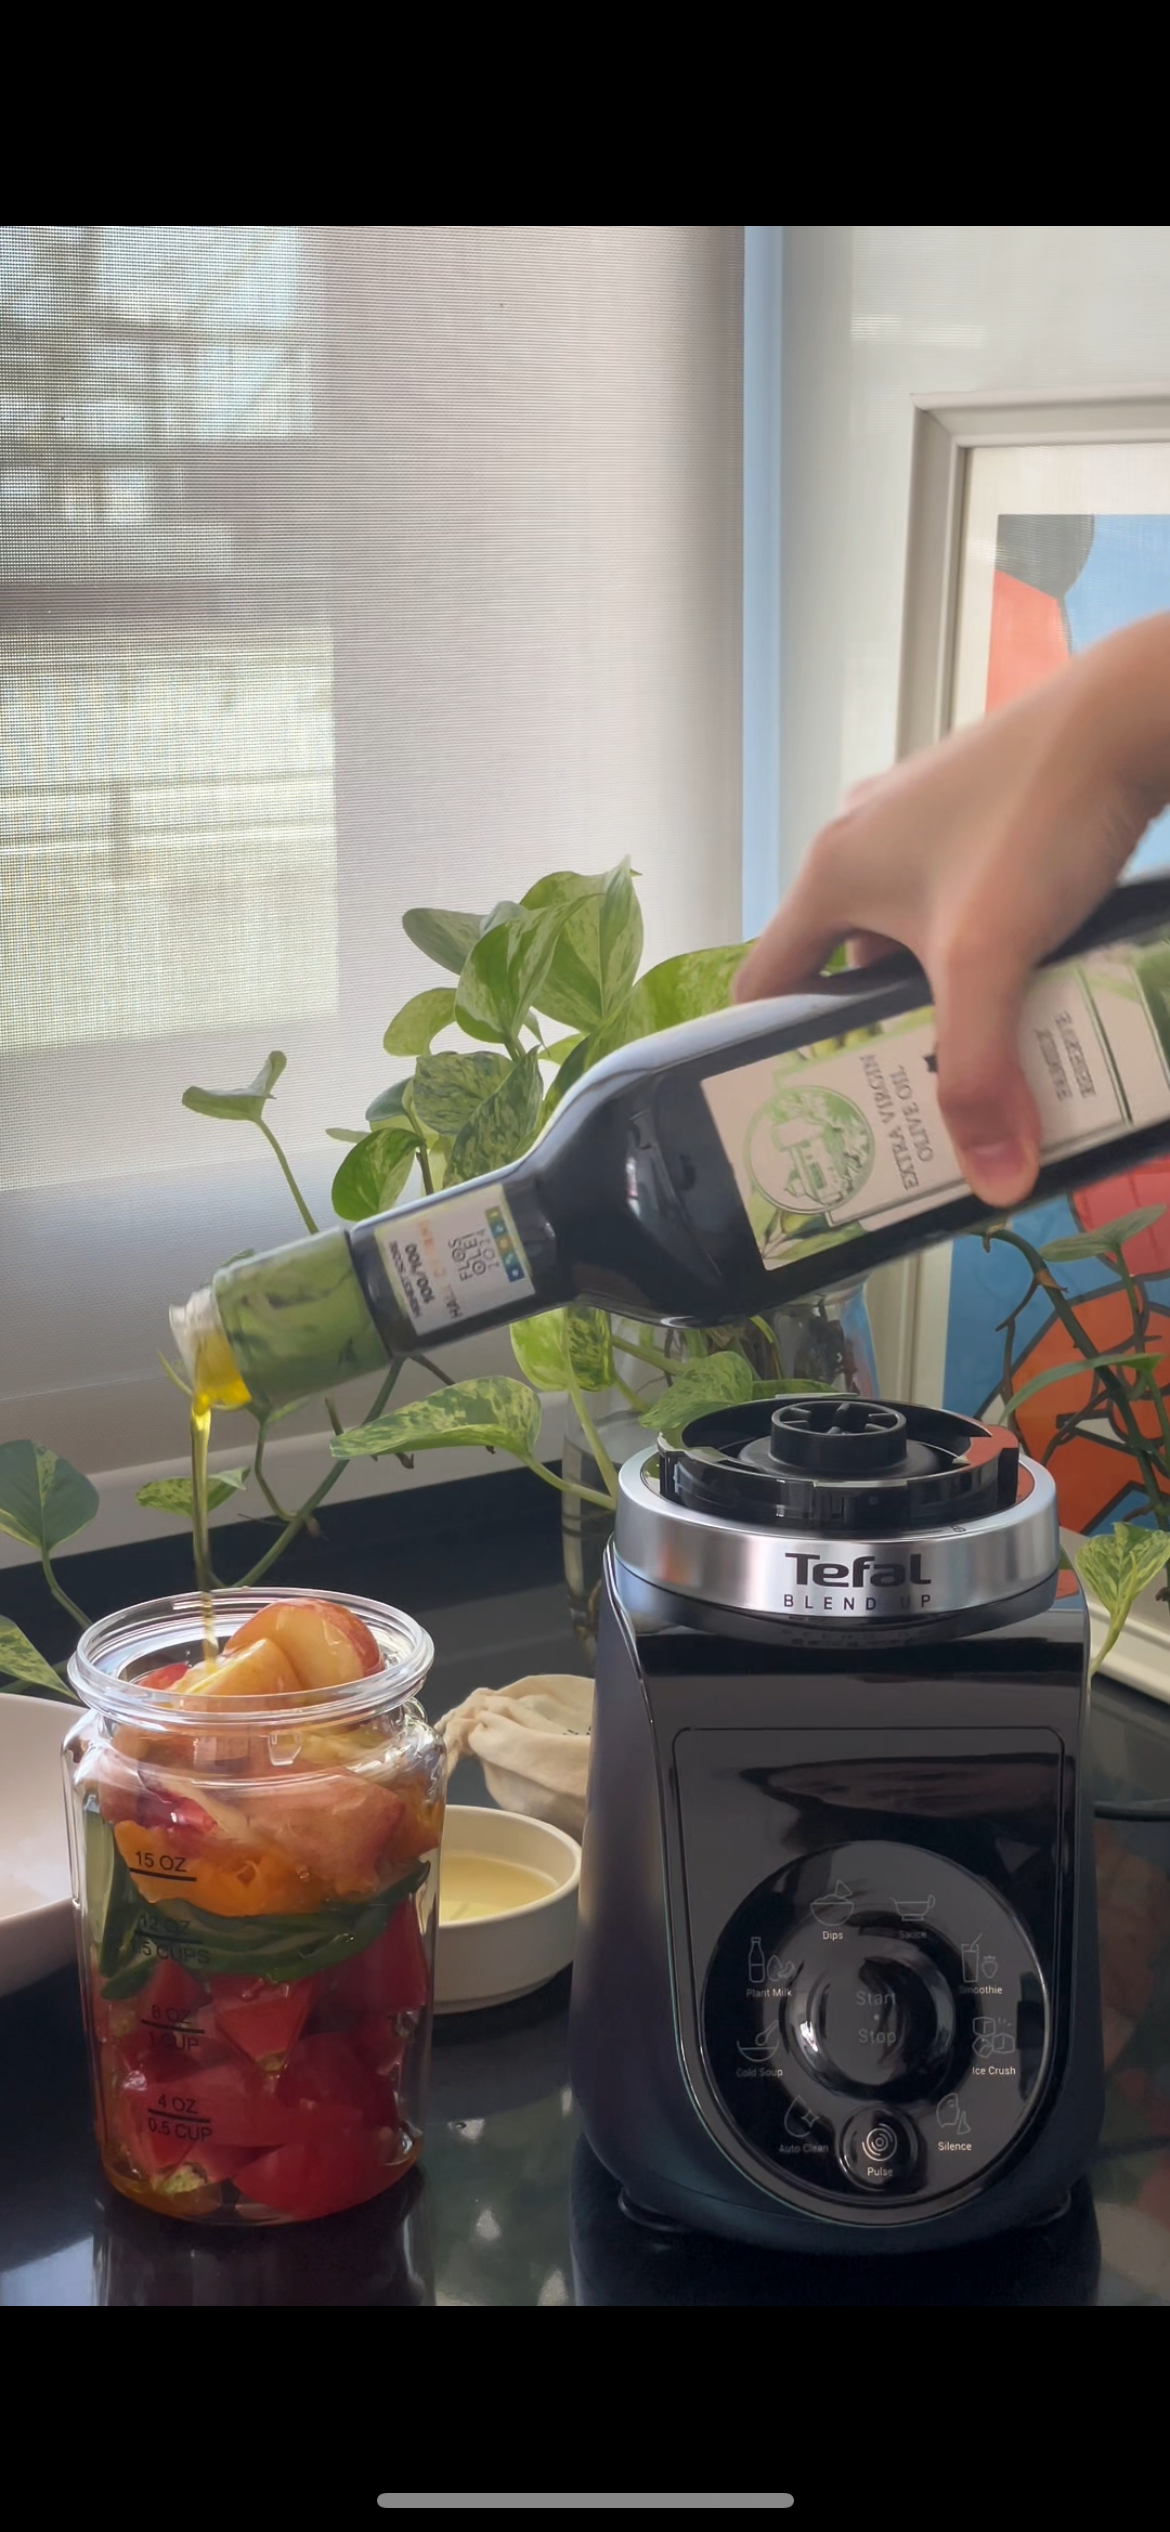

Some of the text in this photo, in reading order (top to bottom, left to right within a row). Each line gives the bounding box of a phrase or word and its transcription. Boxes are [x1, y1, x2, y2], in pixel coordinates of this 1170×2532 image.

[859, 1053, 919, 1190] EXTRA VIRGIN
[888, 1064, 934, 1163] OLIVE OIL
[446, 1237, 473, 1281] FLOS
[460, 1231, 487, 1276] OLEI
[405, 1243, 435, 1305] 100/100
[785, 1553, 932, 1588] Tefal
[784, 1594, 931, 1610] BLEND UP
[135, 1850, 188, 1873] 15 OZ
[139, 1915, 190, 1935] 12 OZ
[899, 1930, 927, 1939] Sauce
[822, 1931, 843, 1941] Dips
[156, 1944, 210, 1964] CUPS
[747, 1989, 792, 1997] Plant Milk
[856, 1992, 896, 2005] Start
[959, 1985, 1002, 1994] Smoothie
[151, 2005, 191, 2024] 8 OZ
[160, 2033, 199, 2052] CUP
[858, 2030, 896, 2045] Stop
[737, 2068, 783, 2078] Cold Soup
[972, 2067, 1016, 2075] Ice Crush
[158, 2095, 198, 2114] 4 OZ
[148, 2118, 212, 2140] 0.5 CUP
[779, 2144, 829, 2152] Auto Clean
[938, 2142, 972, 2151] Silence
[867, 2167, 893, 2176] Pulse
